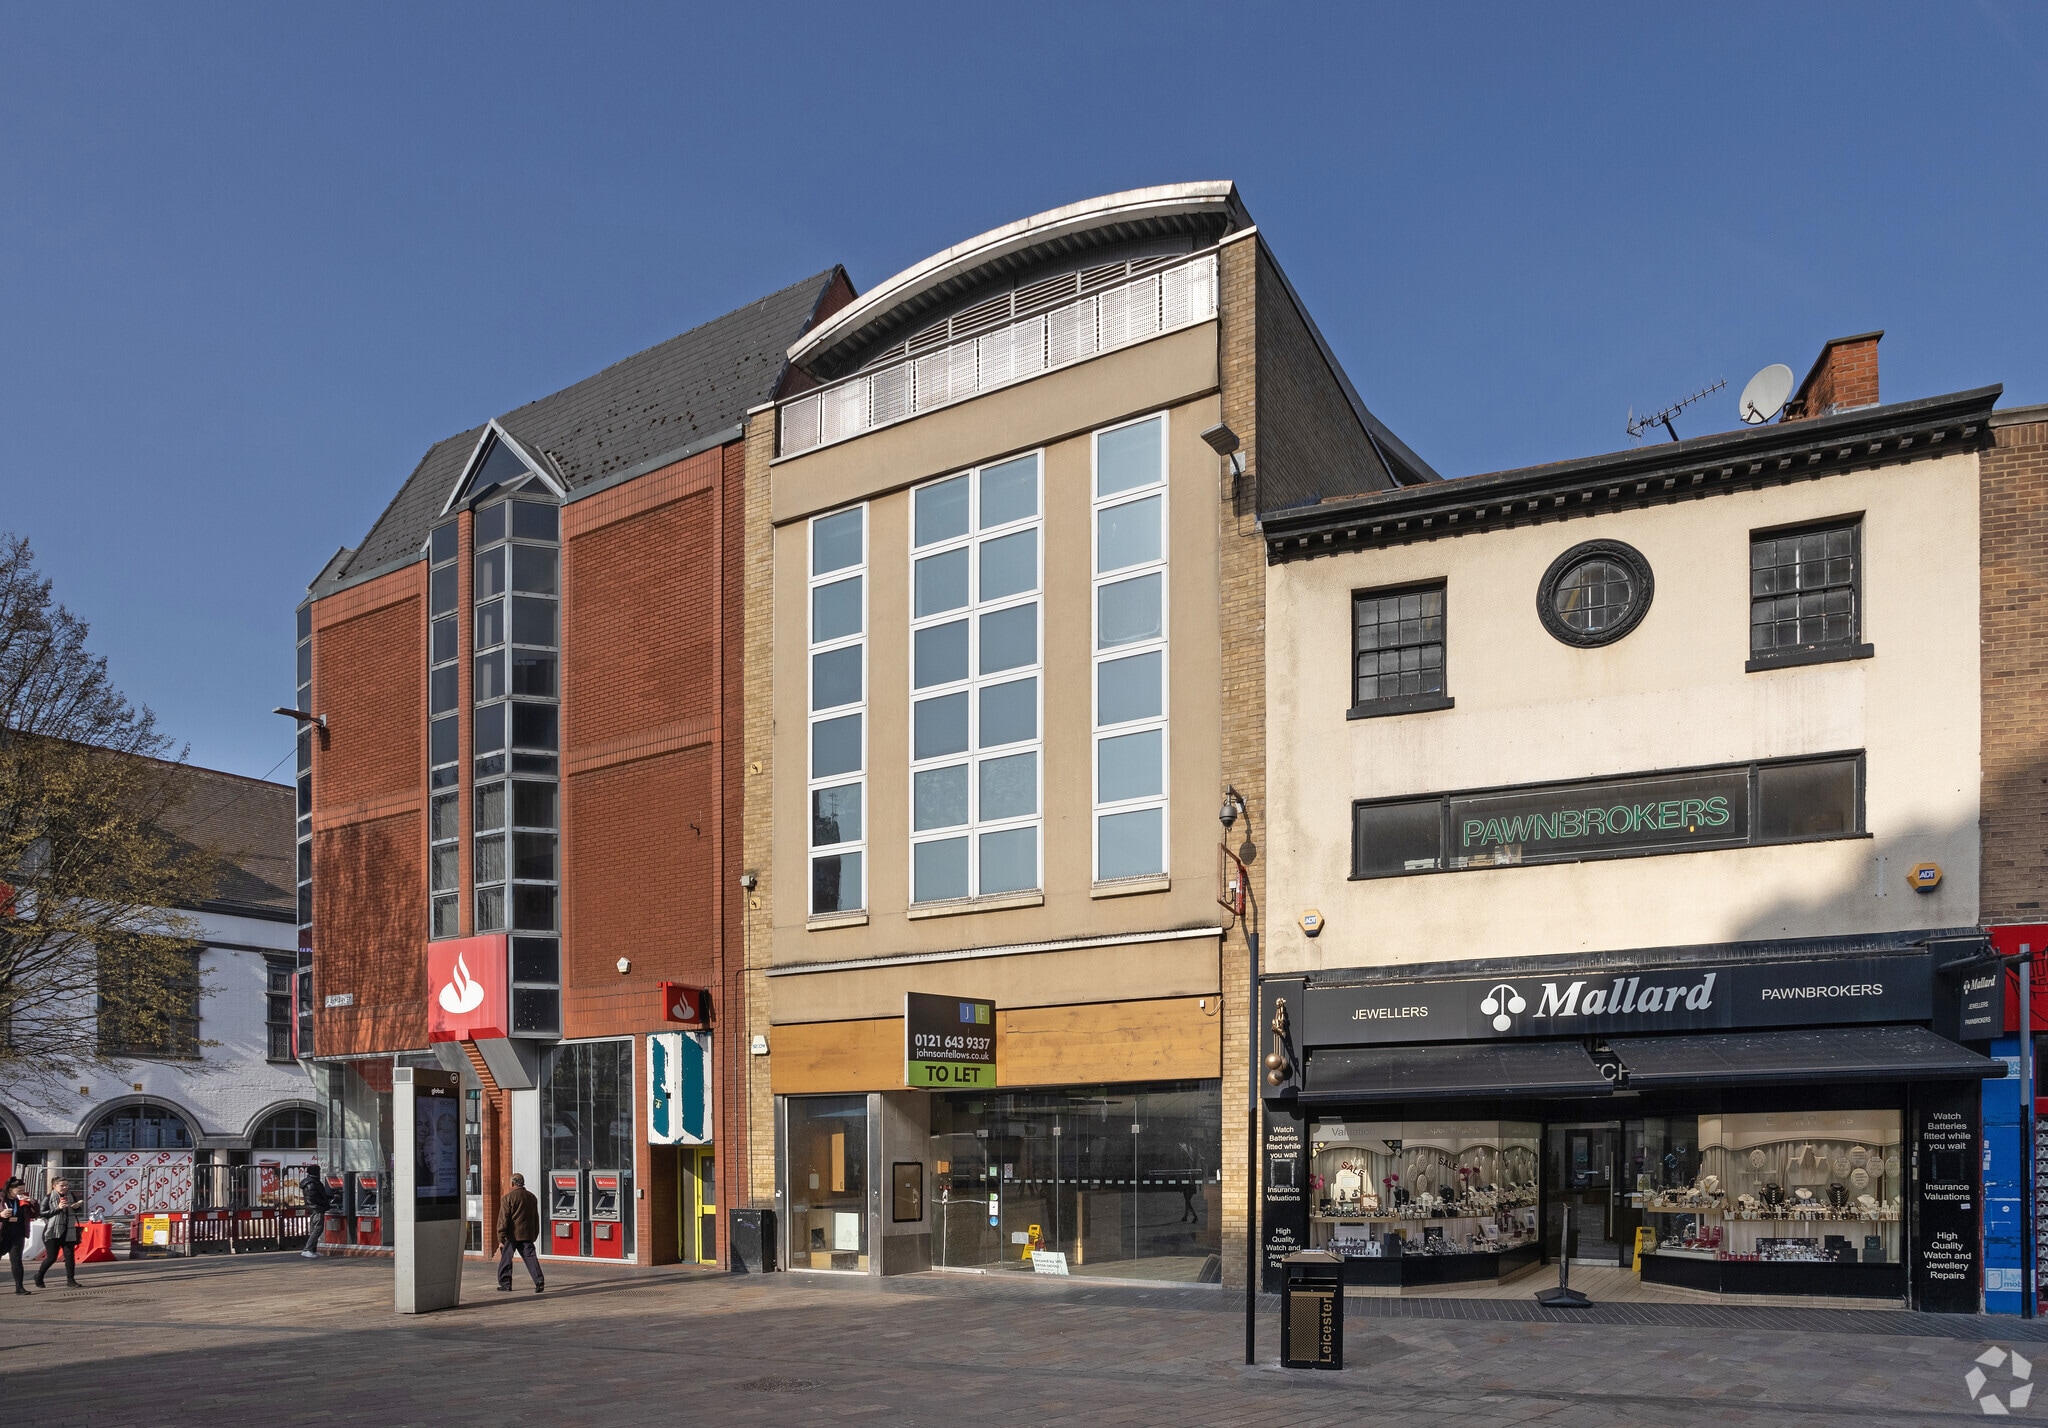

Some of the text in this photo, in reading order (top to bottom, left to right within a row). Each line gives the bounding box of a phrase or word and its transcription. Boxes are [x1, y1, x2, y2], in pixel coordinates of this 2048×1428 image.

[1463, 796, 1730, 846] PAWNBROKERS
[1920, 870, 1935, 878] ADT
[1970, 974, 1996, 990] Mallard
[1532, 972, 1717, 1018] Mallard
[1762, 984, 1882, 1000] PAWNBROKERS
[1352, 1006, 1428, 1020] JEWELLERS
[915, 1034, 990, 1050] 0121 643 9337
[916, 1048, 990, 1060] johnsonfellows.co.uk
[925, 1066, 981, 1082] TO LET
[1341, 1161, 1365, 1178] SALE
[1438, 1157, 1458, 1171] SALE
[108, 1178, 138, 1204] £2.49
[1937, 1232, 1958, 1241] High
[1932, 1242, 1963, 1251] Quality
[1926, 1261, 1969, 1271] Jewellery
[1930, 1271, 1965, 1280] Repairs
[1320, 1298, 1333, 1362] Leicester
